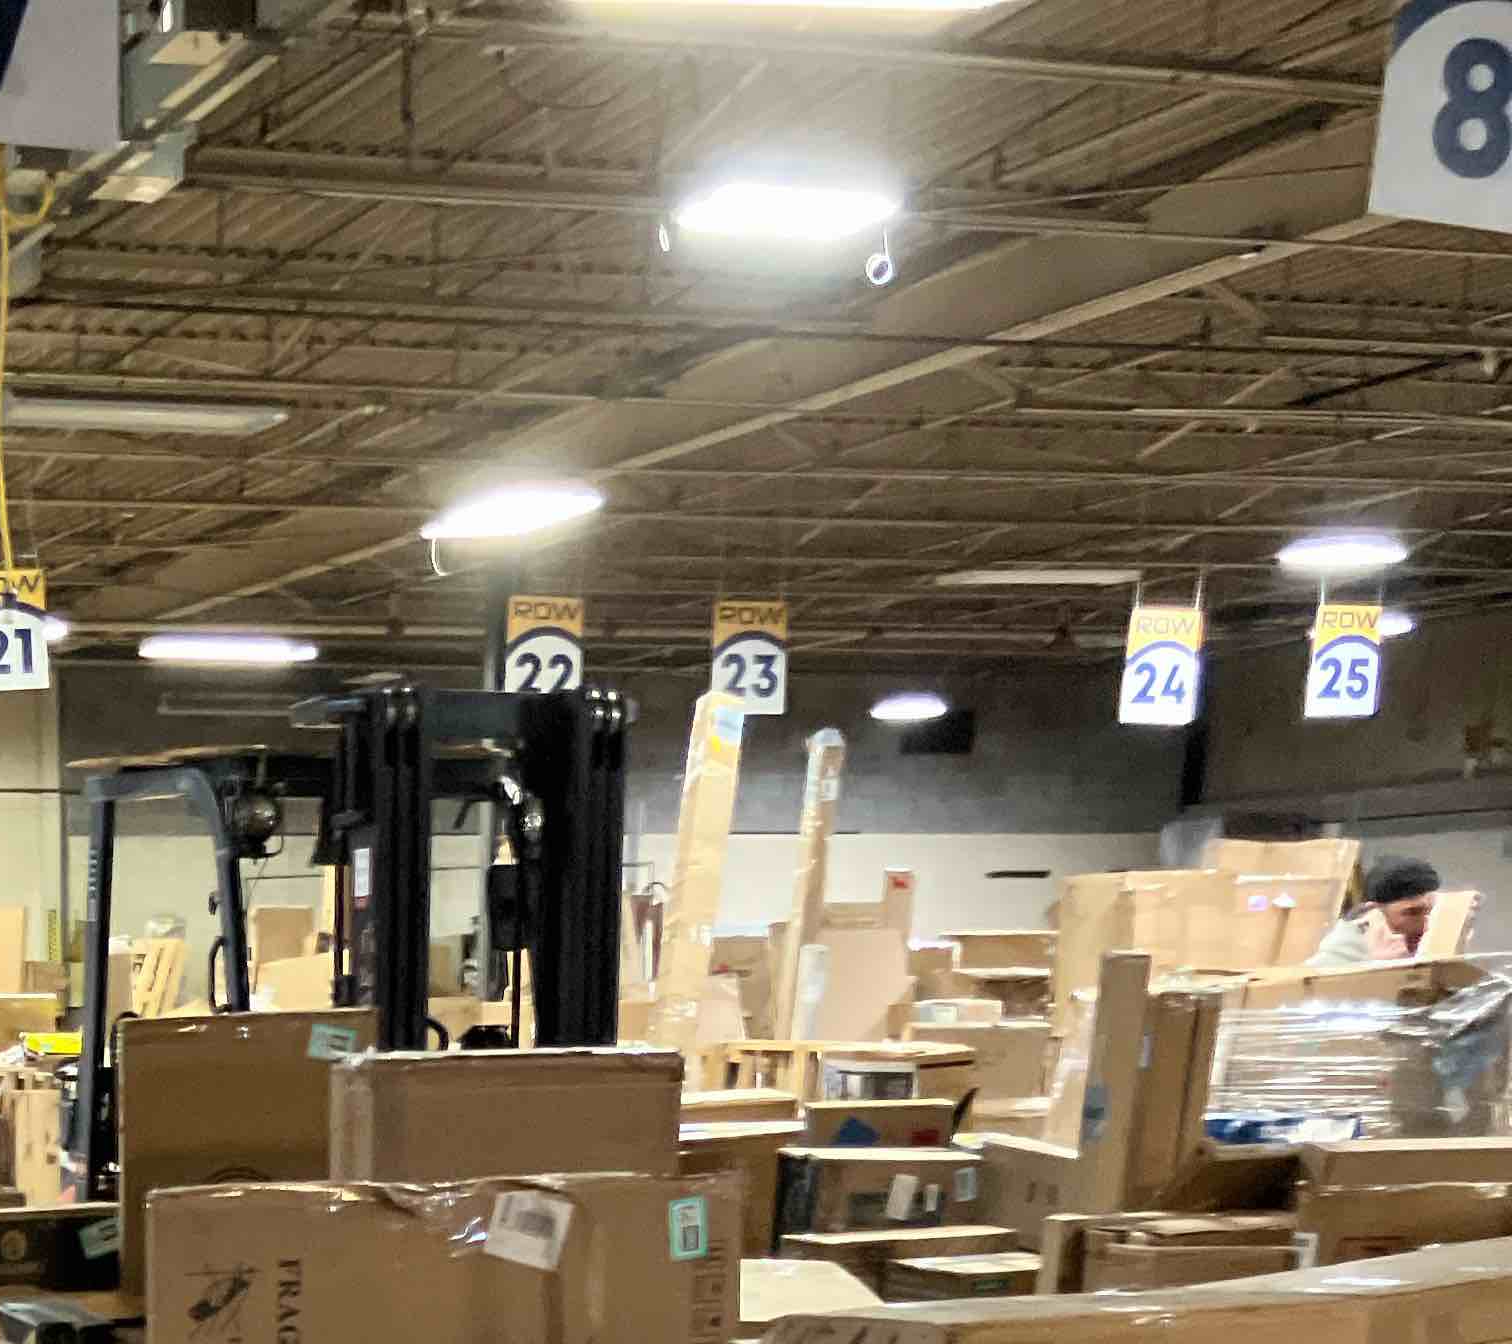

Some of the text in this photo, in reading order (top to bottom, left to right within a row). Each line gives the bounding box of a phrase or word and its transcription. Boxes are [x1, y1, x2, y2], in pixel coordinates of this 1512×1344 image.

[1432, 37, 1512, 179] 8
[513, 602, 578, 621] ROW
[718, 606, 784, 624] ROW
[1135, 616, 1194, 634] ROW
[1322, 611, 1378, 629] ROW
[515, 653, 573, 693] 22
[721, 653, 779, 697] 23
[1131, 663, 1186, 704] 24
[1317, 658, 1369, 700] 25
